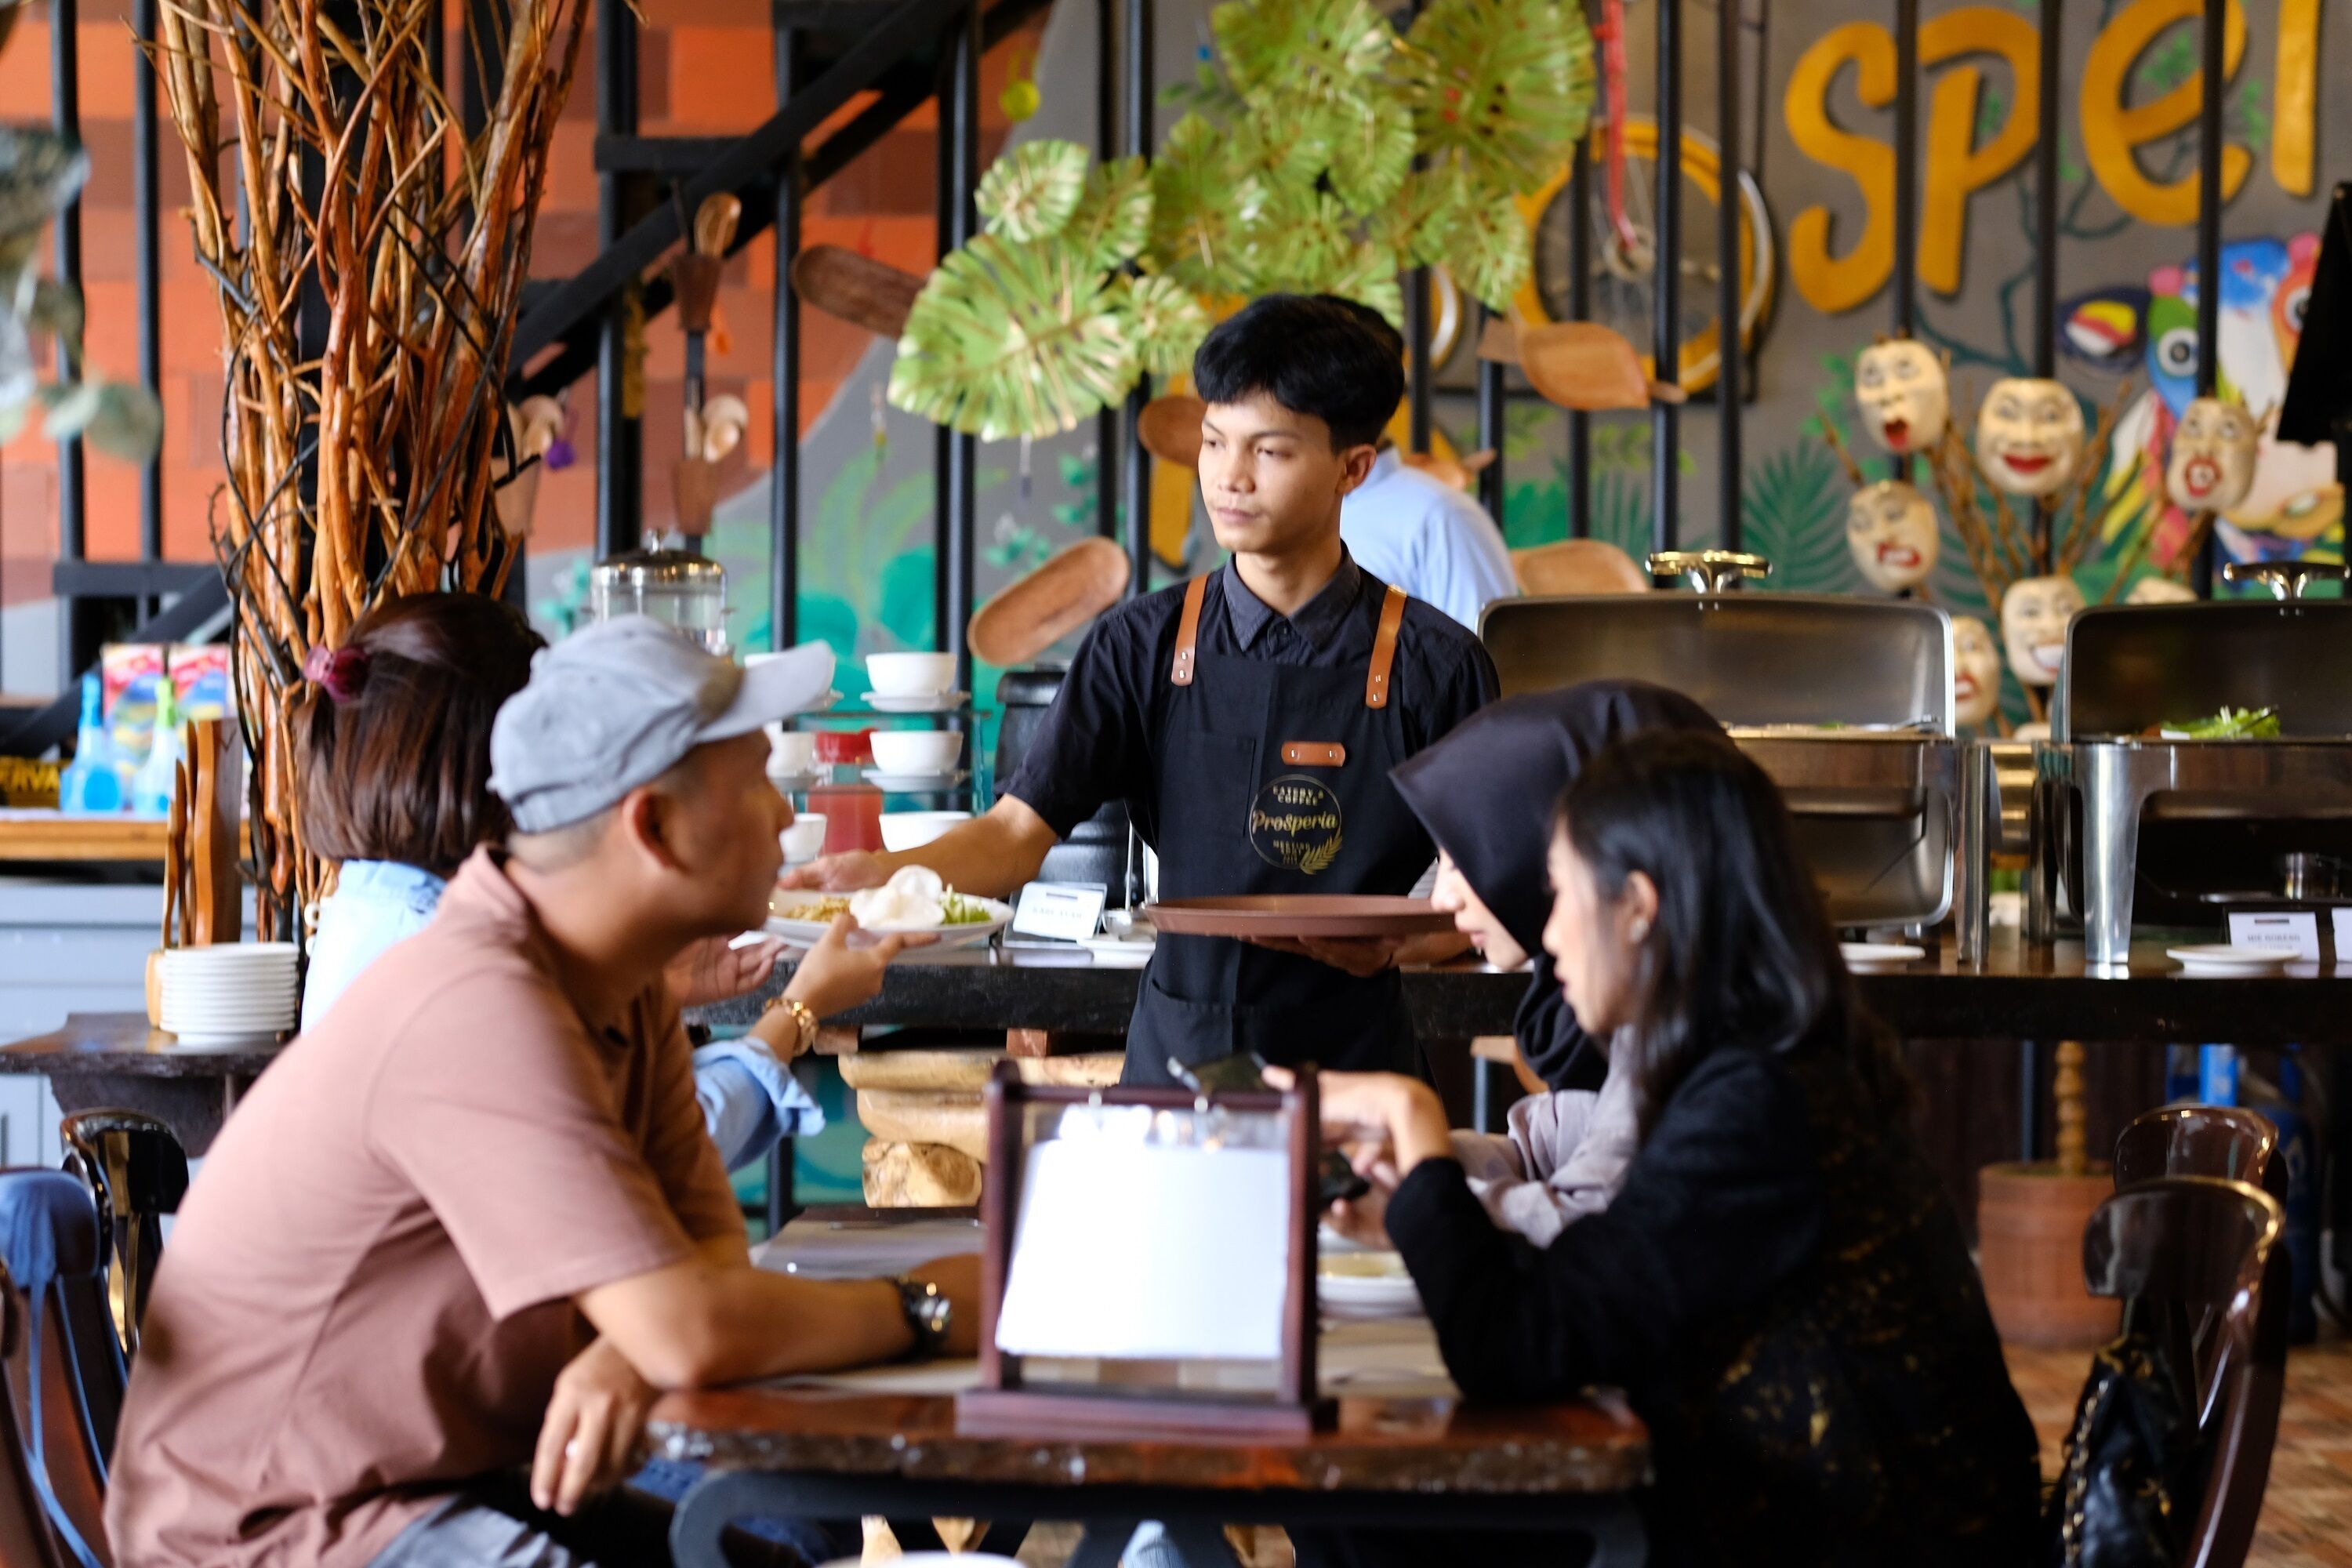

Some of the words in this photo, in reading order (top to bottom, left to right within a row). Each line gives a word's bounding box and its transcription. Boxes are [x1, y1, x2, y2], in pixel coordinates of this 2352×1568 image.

[1272, 785, 1313, 799] EATERY
[1277, 793, 1318, 806] COFFEE
[1252, 809, 1338, 837] Prosperia
